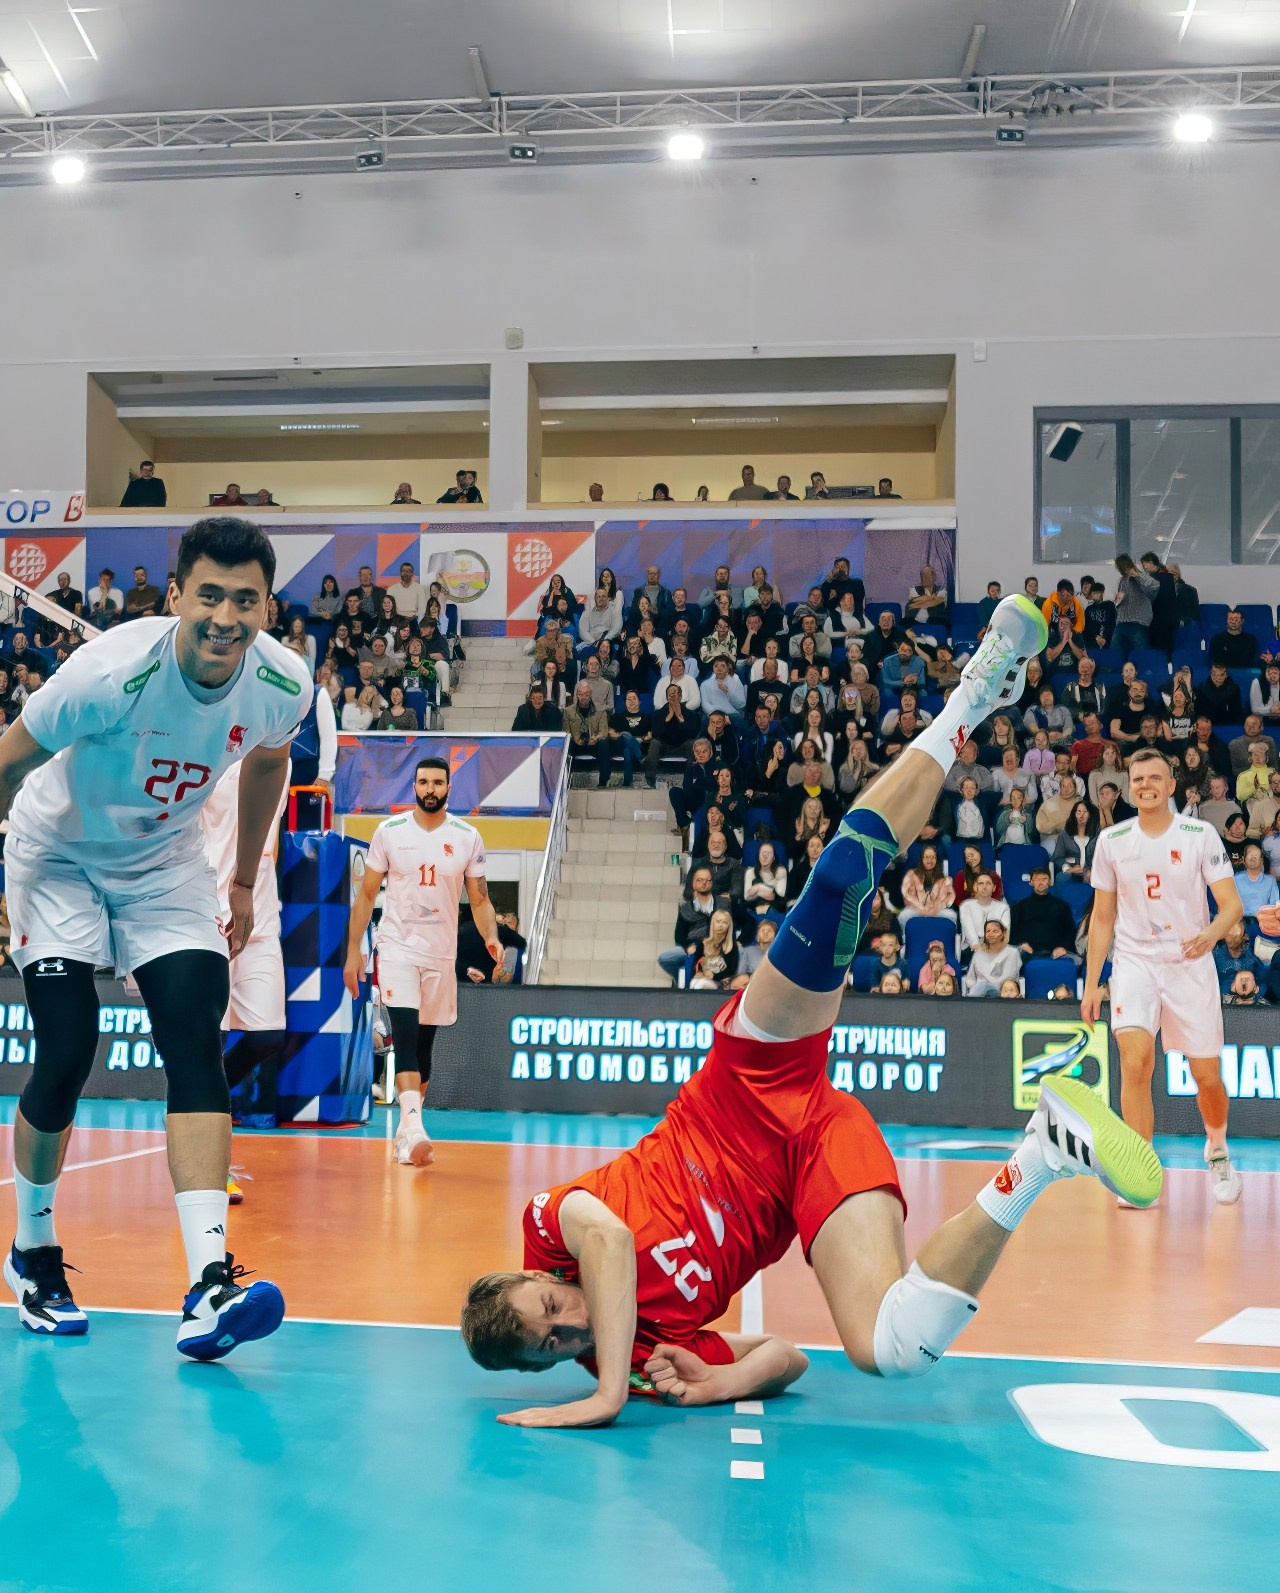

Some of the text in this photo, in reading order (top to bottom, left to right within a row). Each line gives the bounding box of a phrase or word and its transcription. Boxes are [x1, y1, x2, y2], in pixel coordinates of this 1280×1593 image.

[143, 758, 212, 805] 22
[418, 863, 437, 887] 11
[1145, 873, 1161, 900] 2
[510, 1018, 713, 1049] СТРОИТЕЛЬСТВО
[832, 1061, 944, 1092] ДОРОГ
